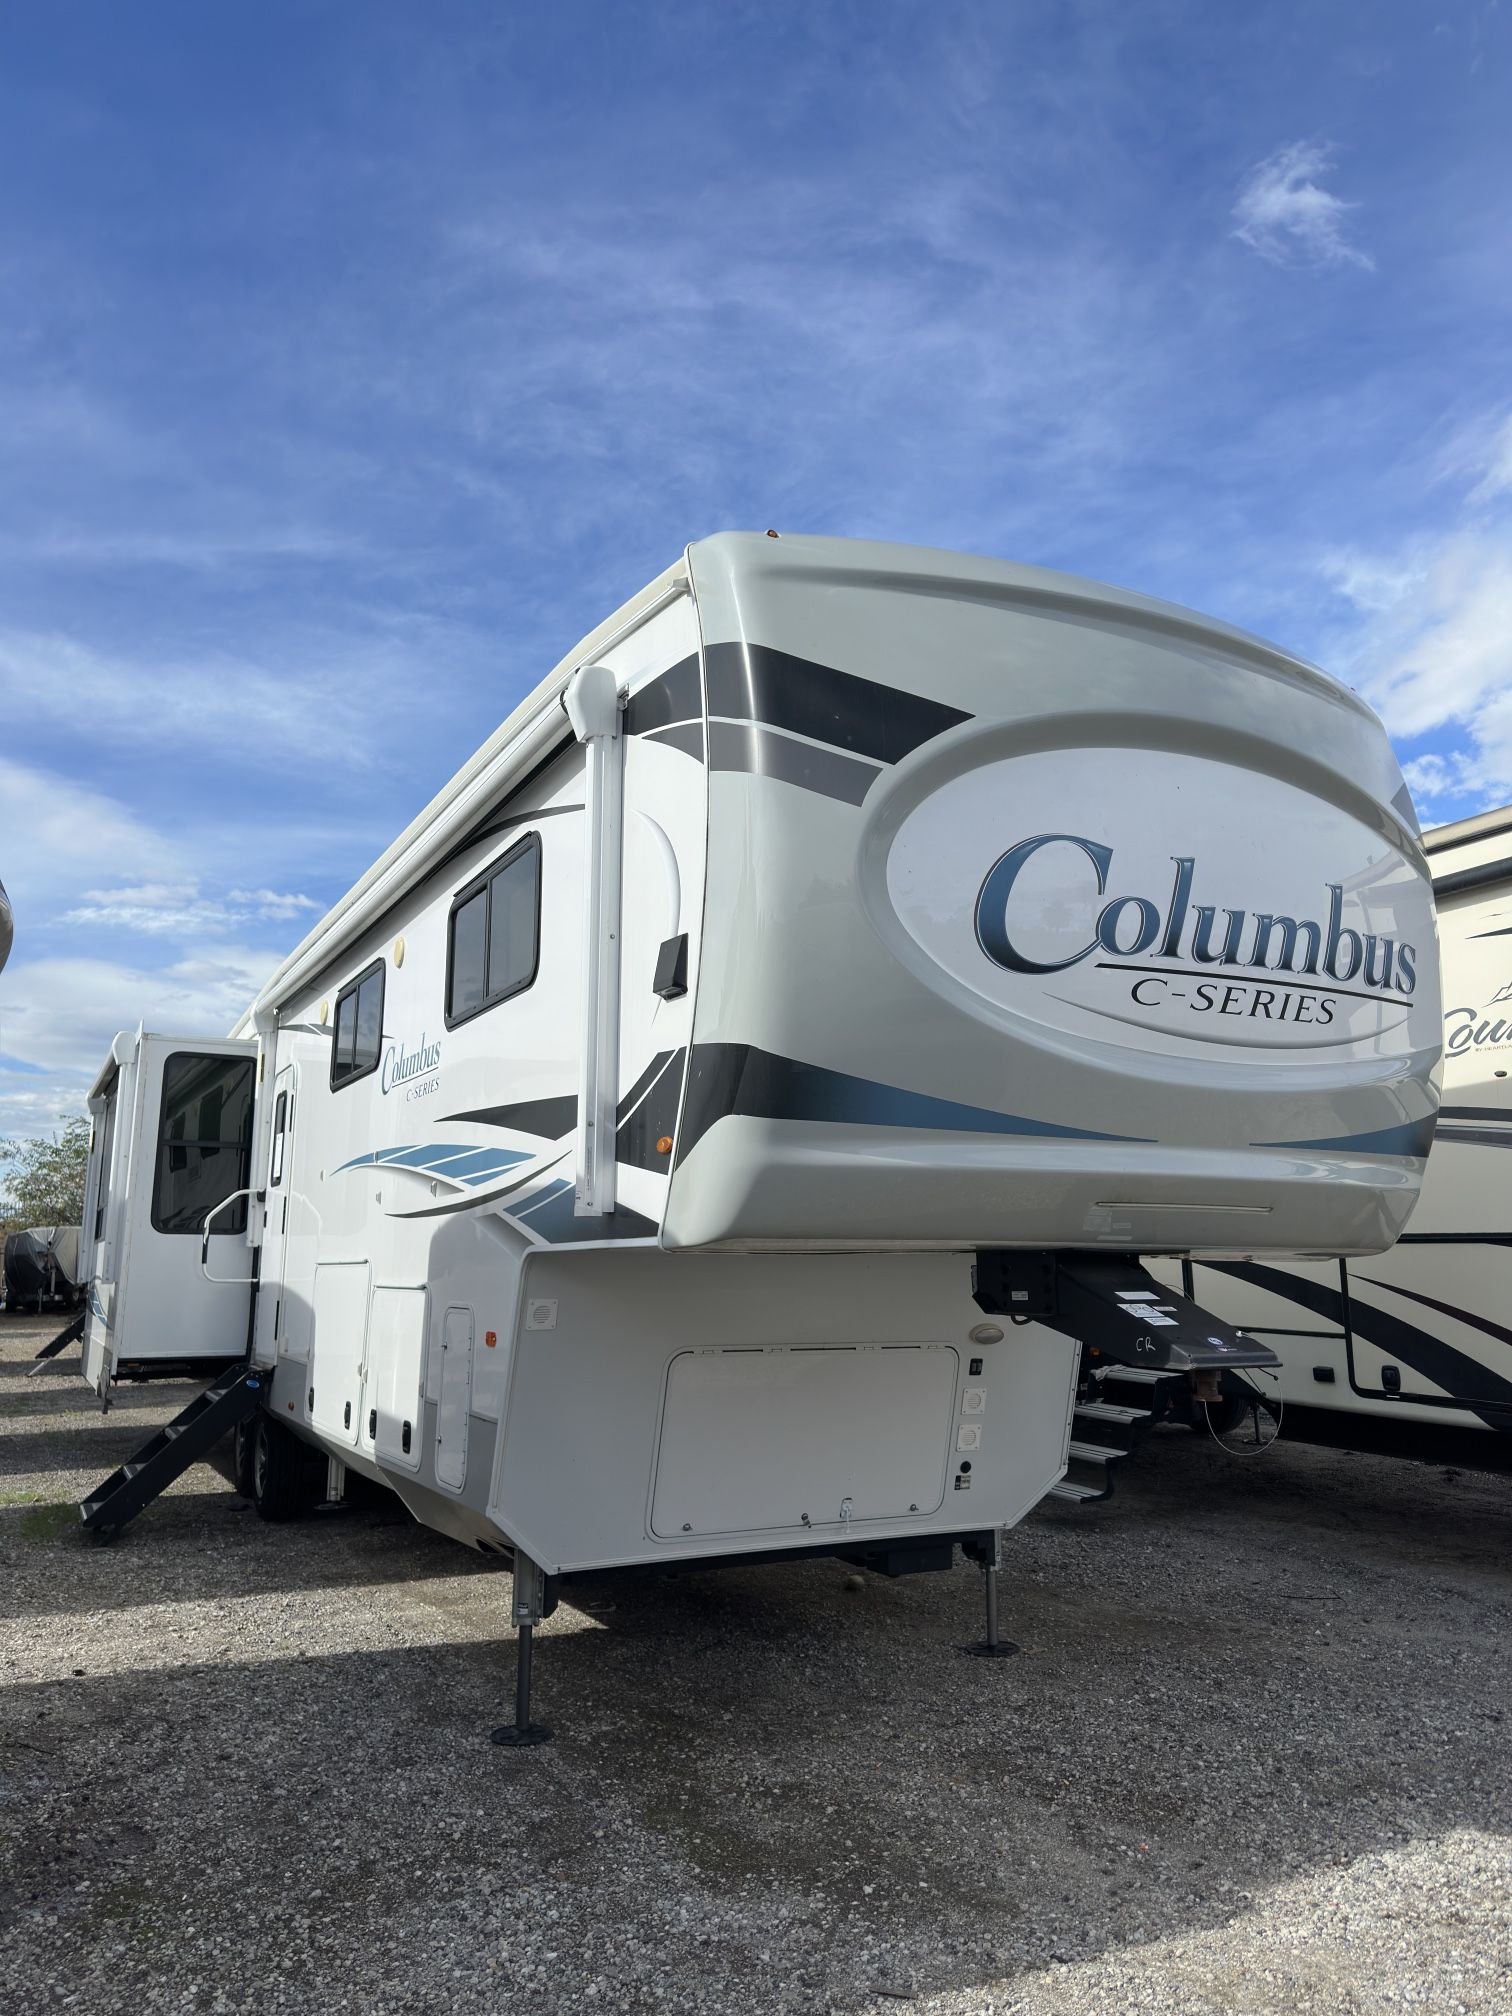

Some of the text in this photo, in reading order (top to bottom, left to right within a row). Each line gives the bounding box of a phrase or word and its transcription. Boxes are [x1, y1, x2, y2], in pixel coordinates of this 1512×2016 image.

[974, 832, 1417, 995] Columbus
[1130, 977, 1338, 1025] C-SERIES
[382, 1032, 441, 1095] Columbus
[407, 1078, 439, 1101] C-SERIES
[1135, 1336, 1156, 1352] CR
